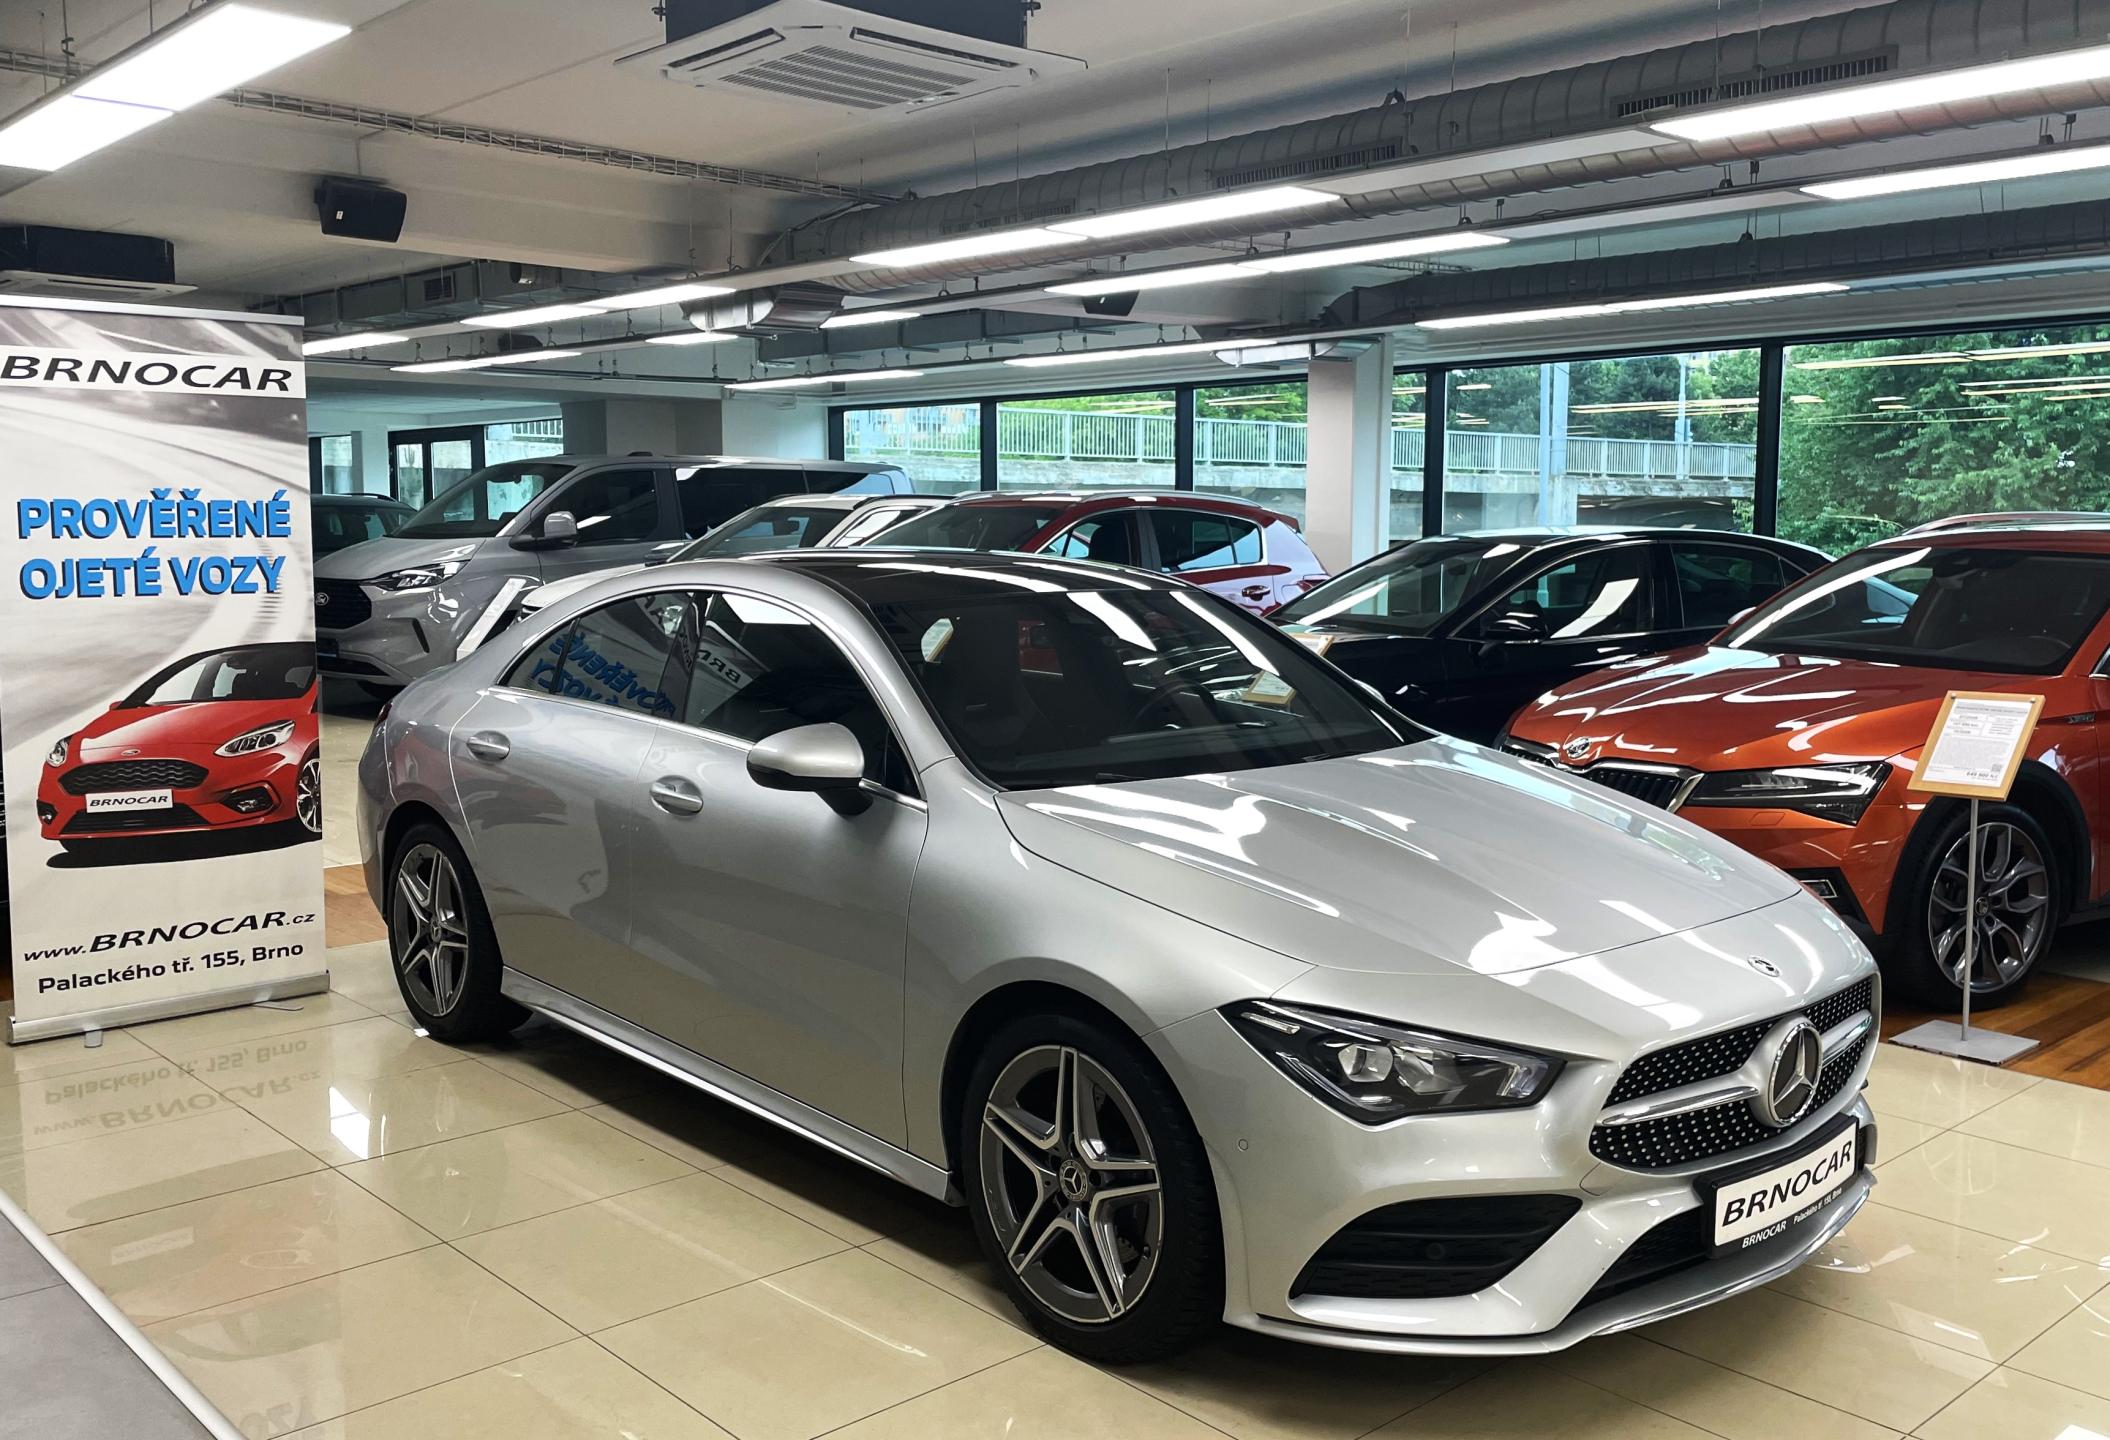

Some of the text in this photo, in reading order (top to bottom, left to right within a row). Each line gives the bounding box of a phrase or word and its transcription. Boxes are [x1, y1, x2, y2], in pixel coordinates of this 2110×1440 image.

[0, 355, 292, 391] BRNOCAR
[17, 488, 292, 539] PROVĚŘENÉ
[19, 546, 286, 599] OJETÉ VOZY
[89, 795, 168, 807] BRNOCAR
[24, 911, 316, 962] www.BRNOCAR.cz
[38, 944, 304, 993] Palackého tř. 155, Brno
[1722, 1140, 1852, 1227] BRNOCAR
[1742, 1220, 1787, 1248] BRNOCAR
